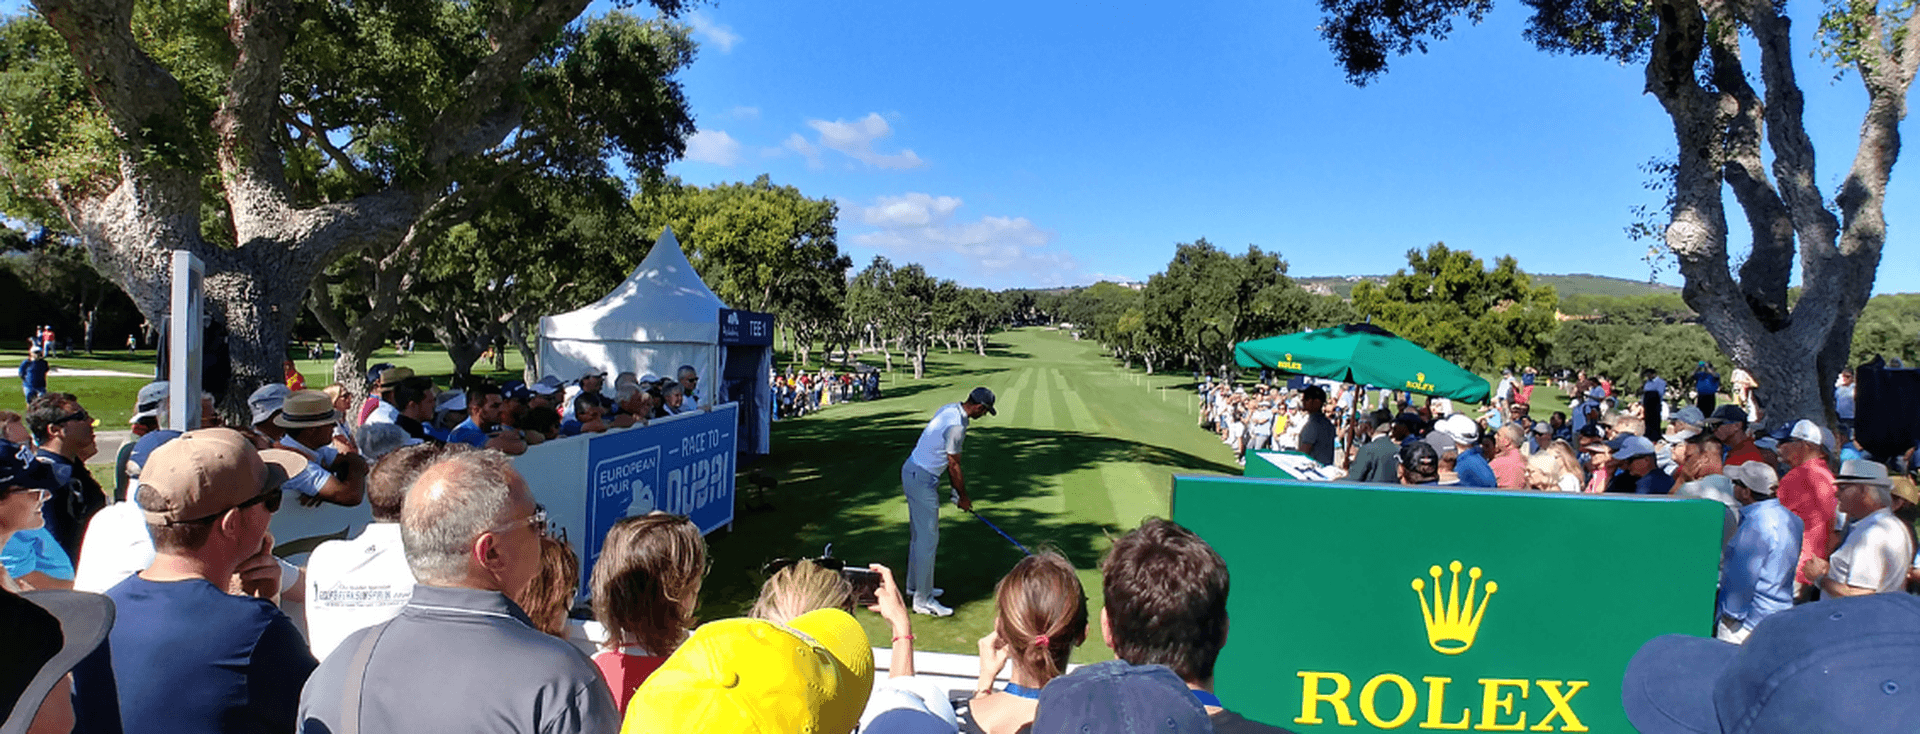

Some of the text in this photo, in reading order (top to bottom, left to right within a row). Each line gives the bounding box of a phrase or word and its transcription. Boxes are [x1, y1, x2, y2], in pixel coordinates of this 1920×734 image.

[750, 320, 762, 336] TEE
[1277, 361, 1302, 370] ROLEX
[1406, 381, 1435, 392] ROLEX
[681, 428, 719, 457] RACE TO
[600, 457, 656, 484] EUROPEAN
[600, 479, 630, 499] TOUR
[667, 450, 729, 515] DUBAI
[1293, 671, 1590, 732] ROLEX
